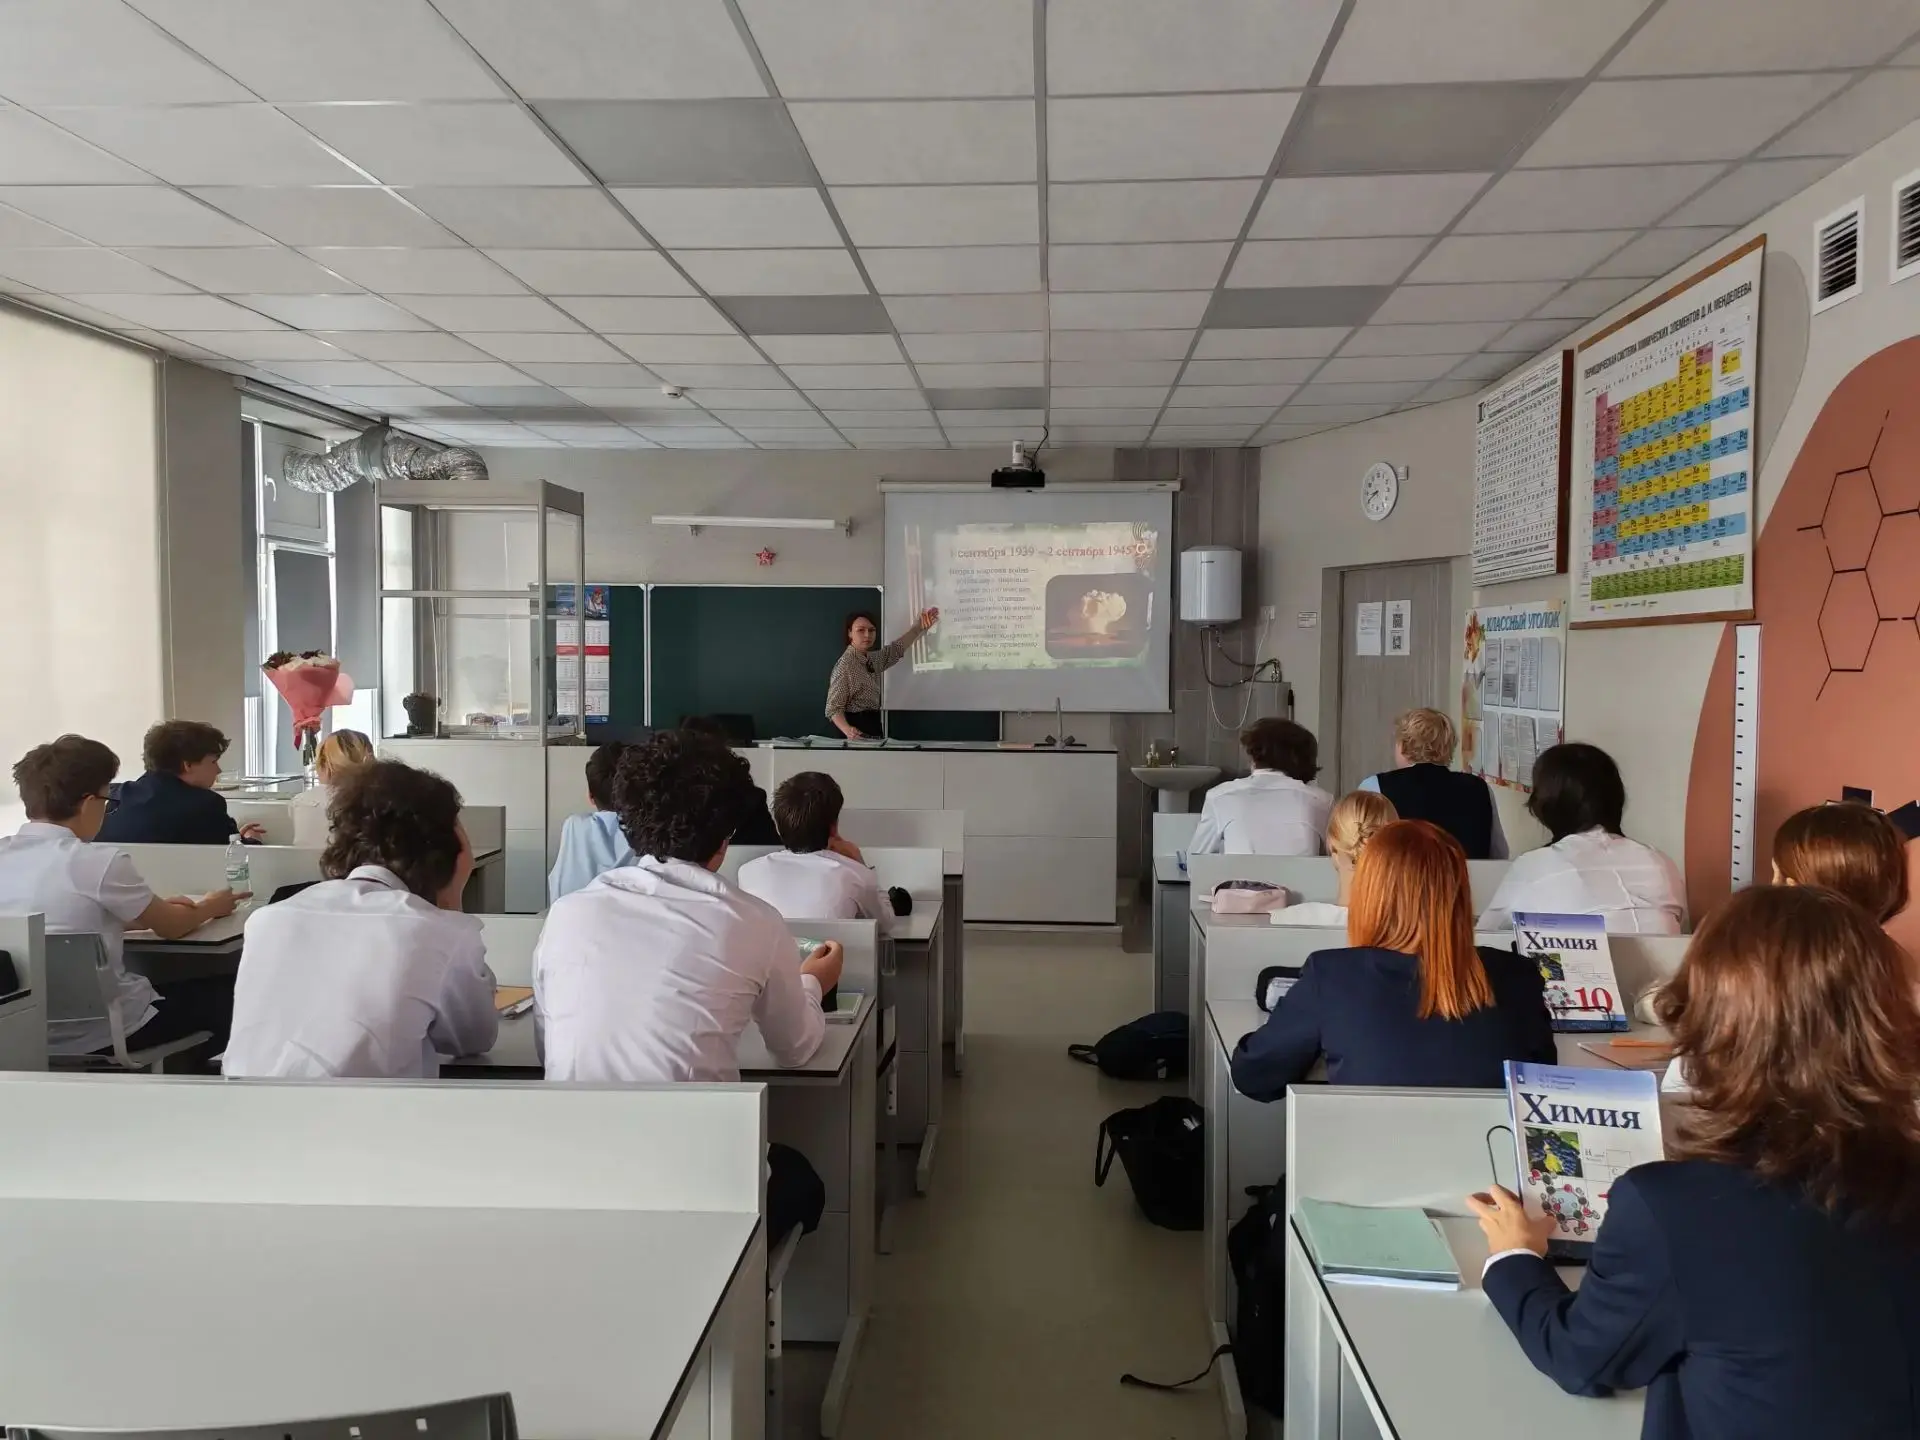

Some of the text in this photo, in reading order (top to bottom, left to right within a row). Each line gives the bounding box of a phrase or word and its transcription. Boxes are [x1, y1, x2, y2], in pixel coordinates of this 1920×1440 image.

[1584, 355, 1618, 380] ПЕРИОДИЧЕСКАЯ
[1617, 343, 1638, 363] СИСТЕМА
[1669, 309, 1700, 335] ЭЛЕМЕНТОВ
[1713, 281, 1752, 311] МЕНДЕЛЕЕВА
[957, 547, 1006, 560] сентября
[1011, 545, 1035, 557] 1939
[1047, 546, 1053, 556] 2
[1056, 546, 1105, 560] сентября
[1108, 544, 1132, 556] 1945
[1486, 611, 1560, 631] КЛАССНЫЙ УГОЛОК
[1523, 931, 1598, 950] Химия
[1574, 986, 1614, 1014] 10
[1519, 1092, 1643, 1131] Химия
